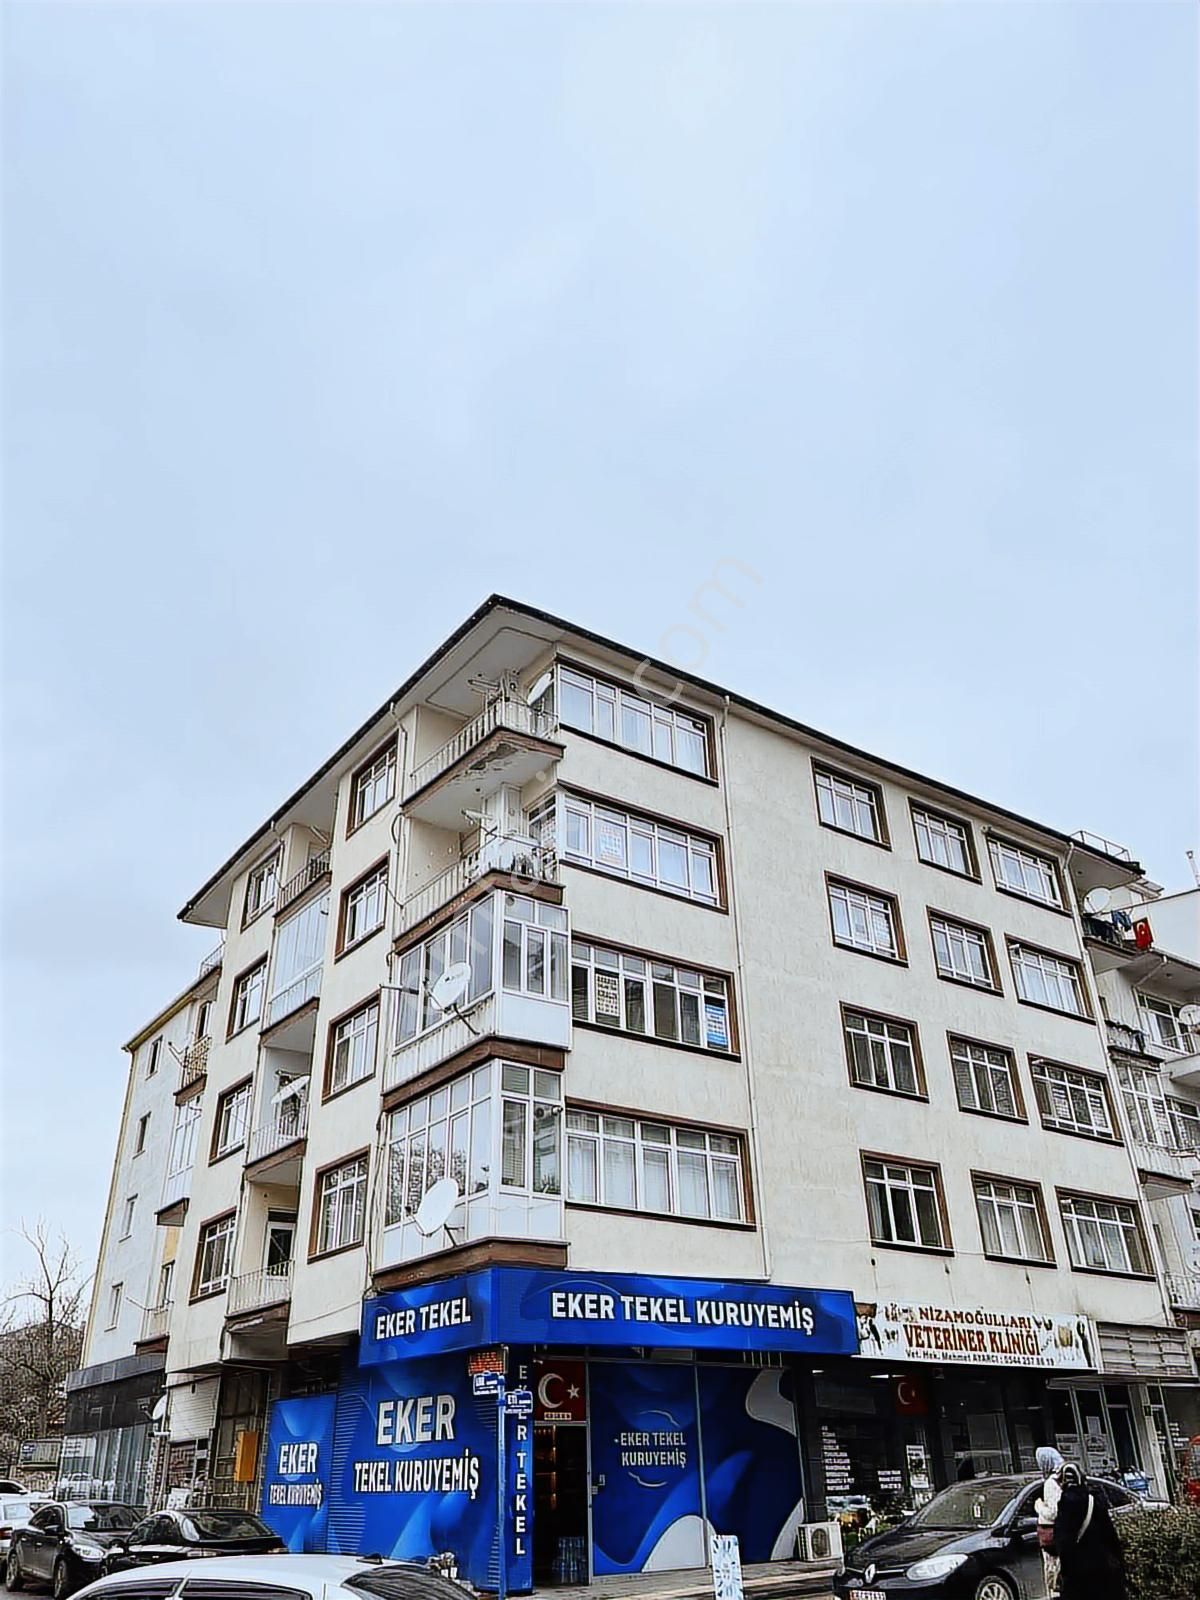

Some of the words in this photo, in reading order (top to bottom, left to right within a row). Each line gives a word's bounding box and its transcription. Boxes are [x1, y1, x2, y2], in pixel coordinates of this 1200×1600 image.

[376, 1309, 416, 1340] EKER
[420, 1297, 471, 1331] TEKEL
[552, 1292, 615, 1320] EKER
[620, 1295, 691, 1323] TEKEL
[696, 1300, 814, 1335] KURUYEMİŞ
[918, 1306, 1032, 1330] NİZAMOĞULLARI
[902, 1323, 987, 1353] VETERİNER
[988, 1328, 1041, 1356] KLİNİĞİ
[377, 1394, 456, 1445] EKER
[516, 1365, 528, 1441] ER
[279, 1442, 318, 1474] EKER
[620, 1432, 650, 1447] EKER
[652, 1431, 687, 1446] TEKEL
[621, 1447, 687, 1469] KURUYEMİŞ
[355, 1461, 392, 1493] TEKEL
[395, 1448, 480, 1500] KURUYEMİŞ
[515, 1452, 528, 1556] TEKEL
